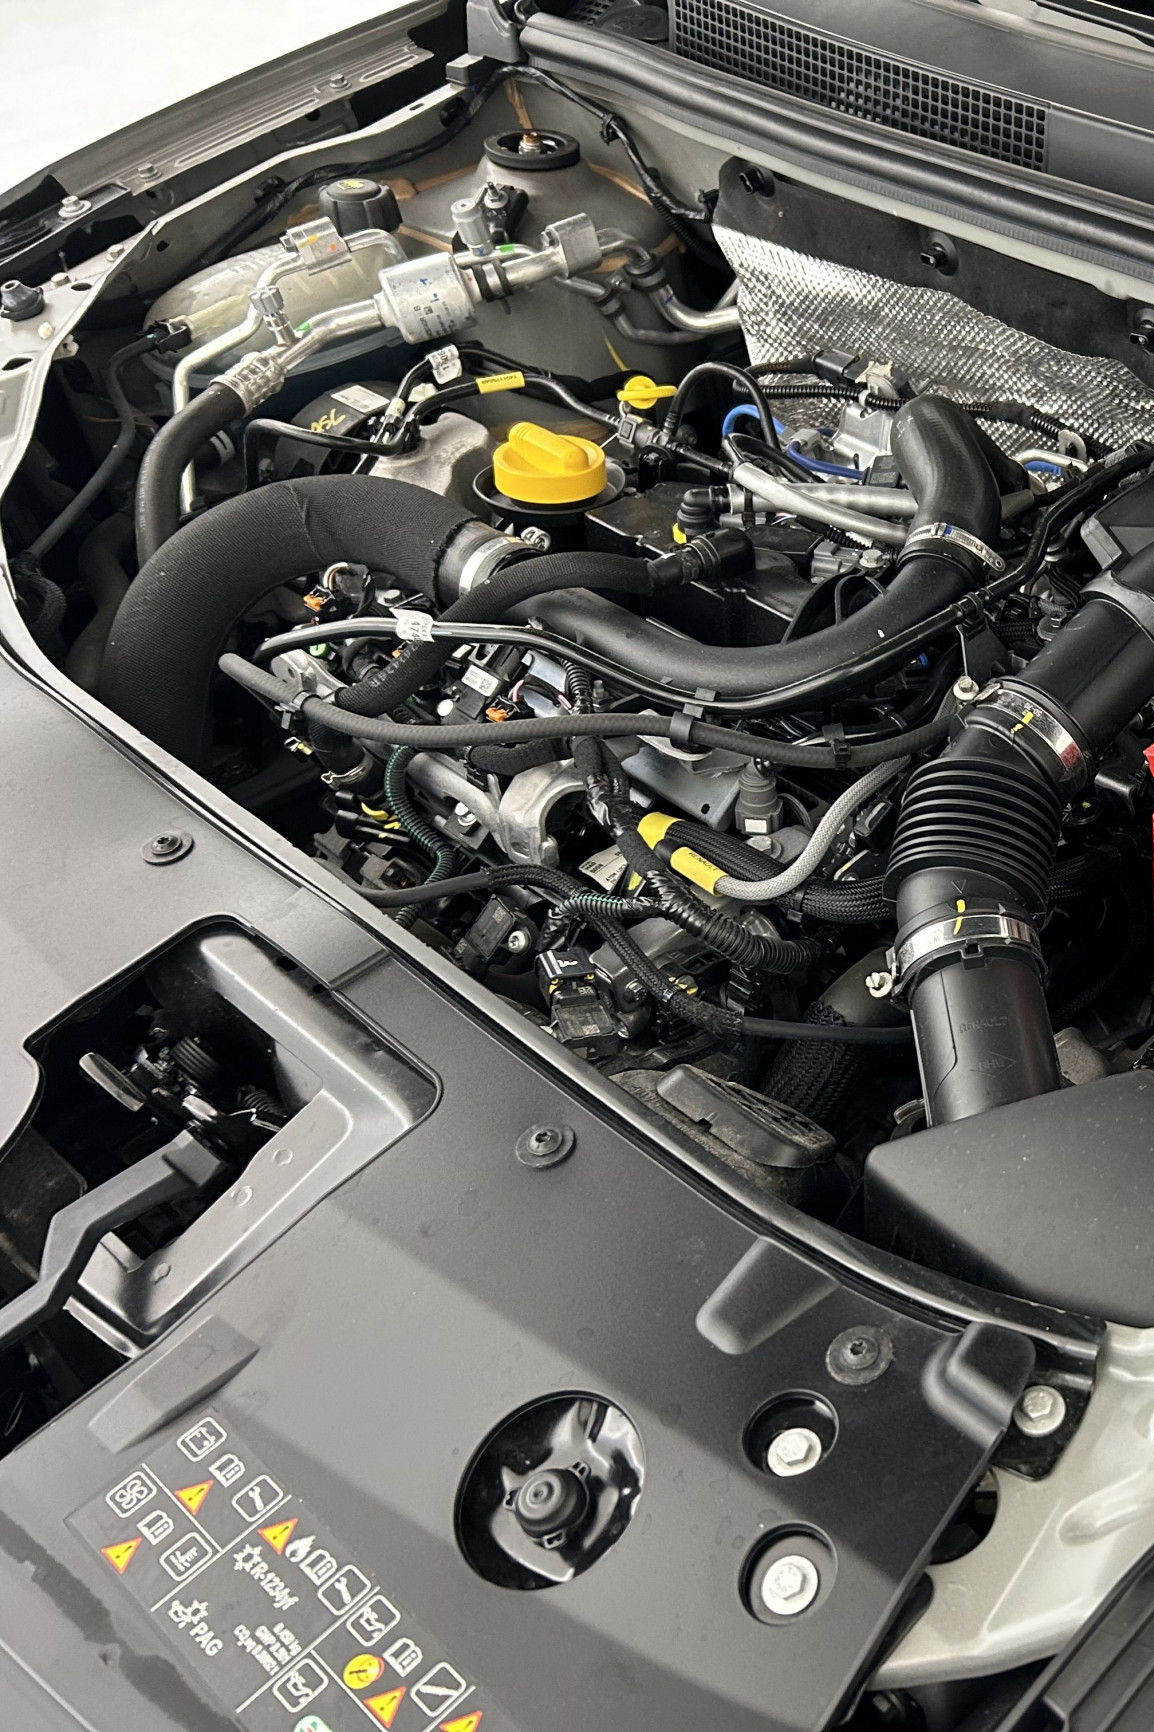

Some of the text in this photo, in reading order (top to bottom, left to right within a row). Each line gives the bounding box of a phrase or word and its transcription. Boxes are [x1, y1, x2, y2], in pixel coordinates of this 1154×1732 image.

[687, 851, 720, 872] RENAULT
[957, 1014, 1008, 1034] RENAULT
[249, 1561, 299, 1610] R-1234yf
[188, 1622, 223, 1657] PAG
